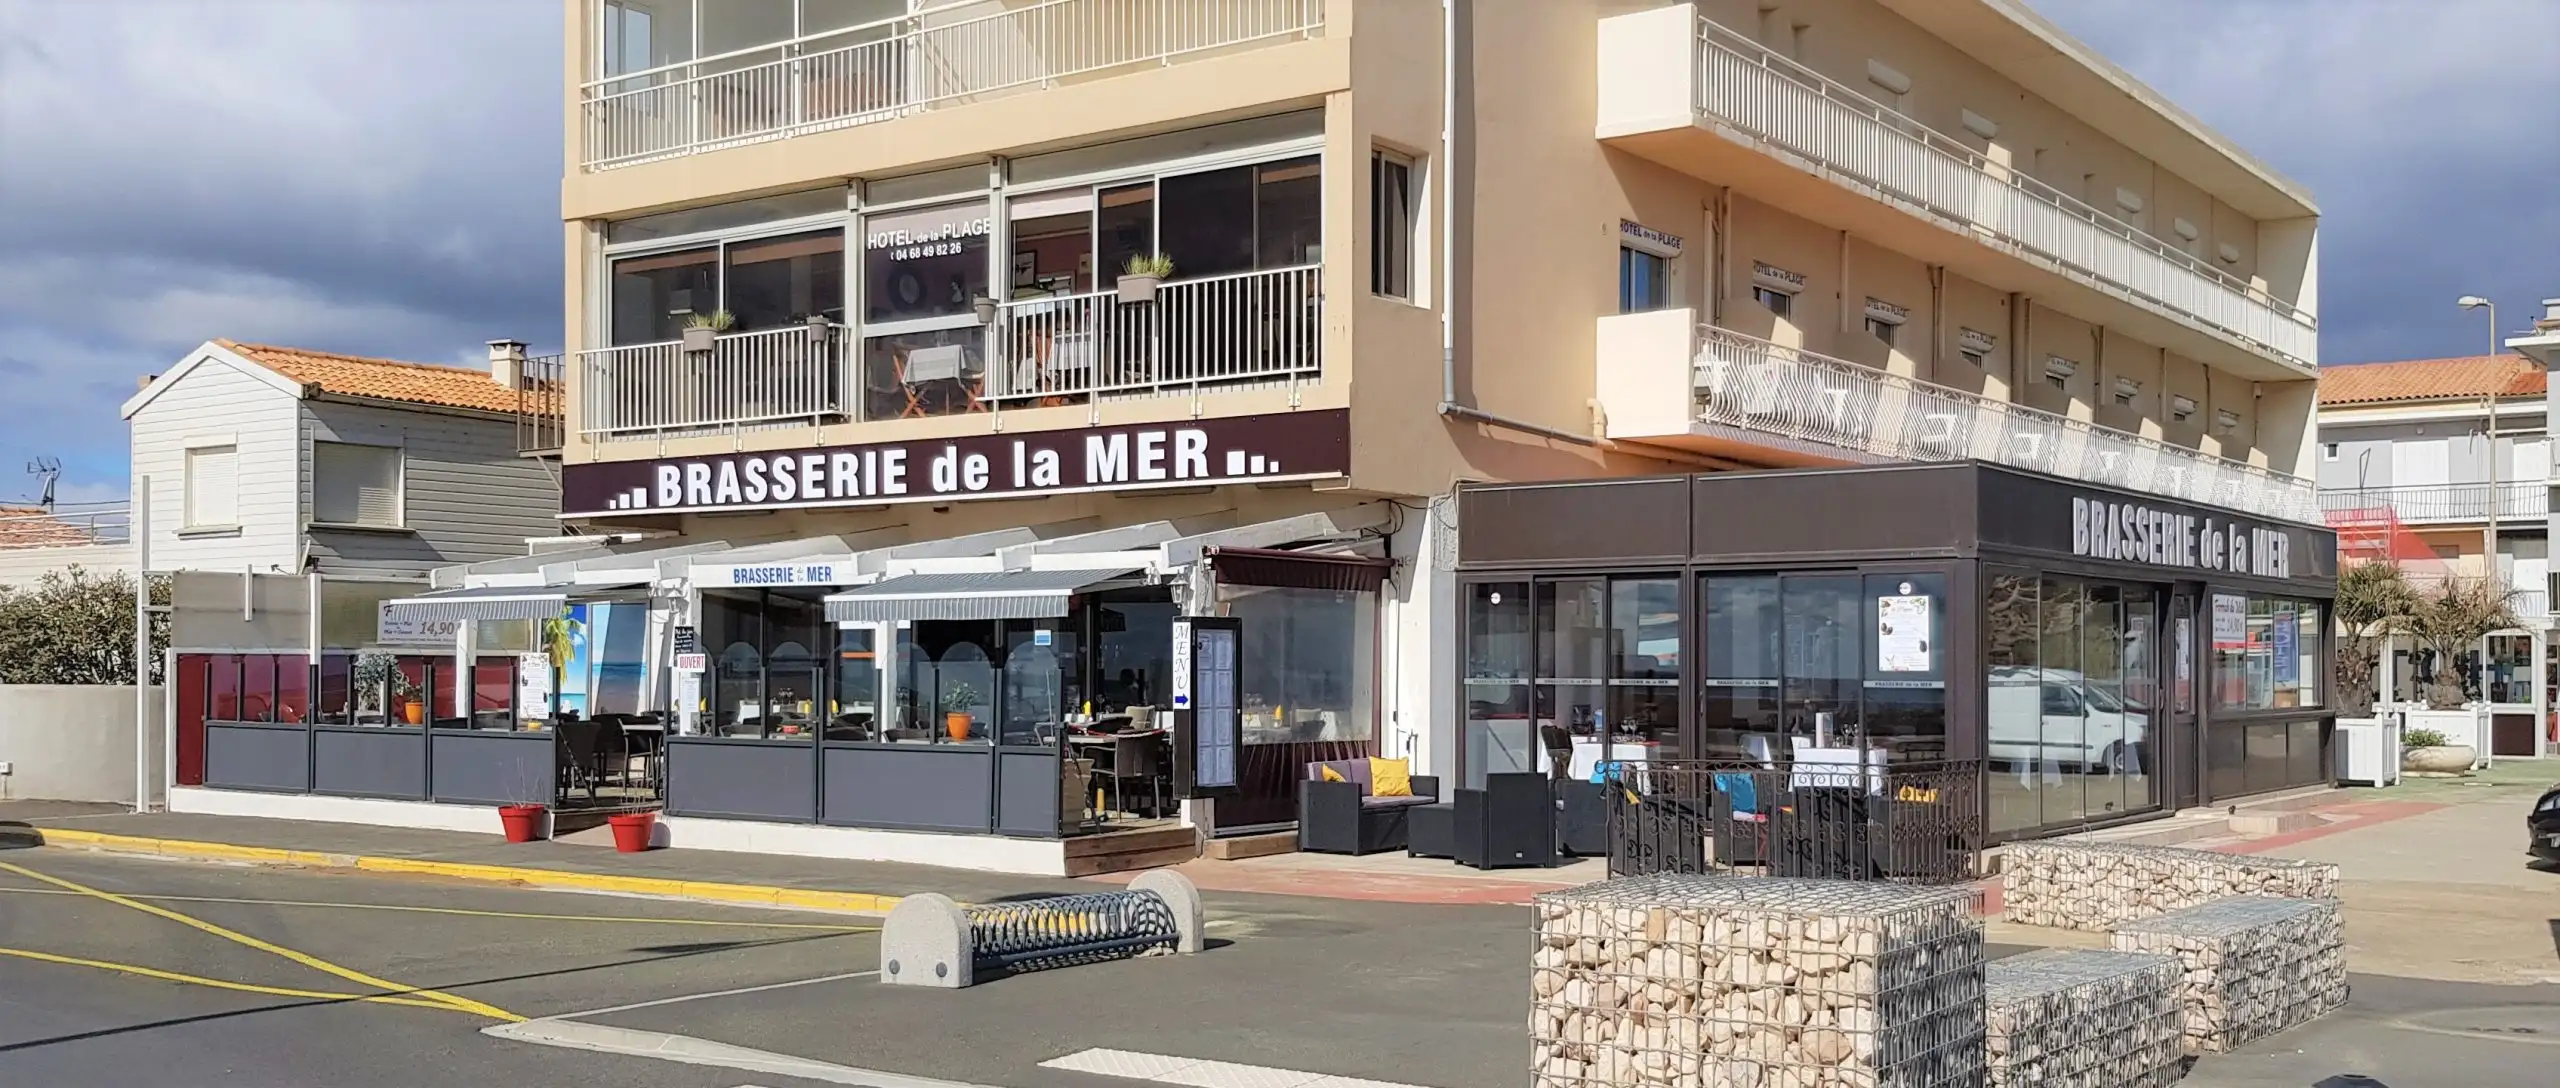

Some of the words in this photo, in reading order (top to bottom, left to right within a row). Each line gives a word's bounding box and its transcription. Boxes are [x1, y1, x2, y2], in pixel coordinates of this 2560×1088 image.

[867, 229, 914, 249] HOTEL
[916, 232, 928, 243] de
[930, 230, 939, 242] la
[942, 217, 991, 240] PLAGE
[1658, 231, 1681, 249] PLAGE
[896, 249, 908, 261] 04
[909, 247, 921, 259] 68
[923, 245, 934, 257] 49
[936, 243, 948, 256] 82
[950, 242, 962, 254] 26
[658, 449, 908, 507] BRASSERIE
[932, 446, 989, 492] de
[1013, 440, 1061, 488] la
[1086, 429, 1210, 484] MER
[2073, 497, 2195, 567] BRASSERIE
[2200, 518, 2223, 571] de
[2229, 523, 2247, 573] la
[2252, 527, 2290, 578] MER
[734, 567, 794, 584] BRASSERIE
[807, 566, 832, 582] MER
[680, 655, 705, 669] OUVERT
[1175, 625, 1189, 689] MENU
